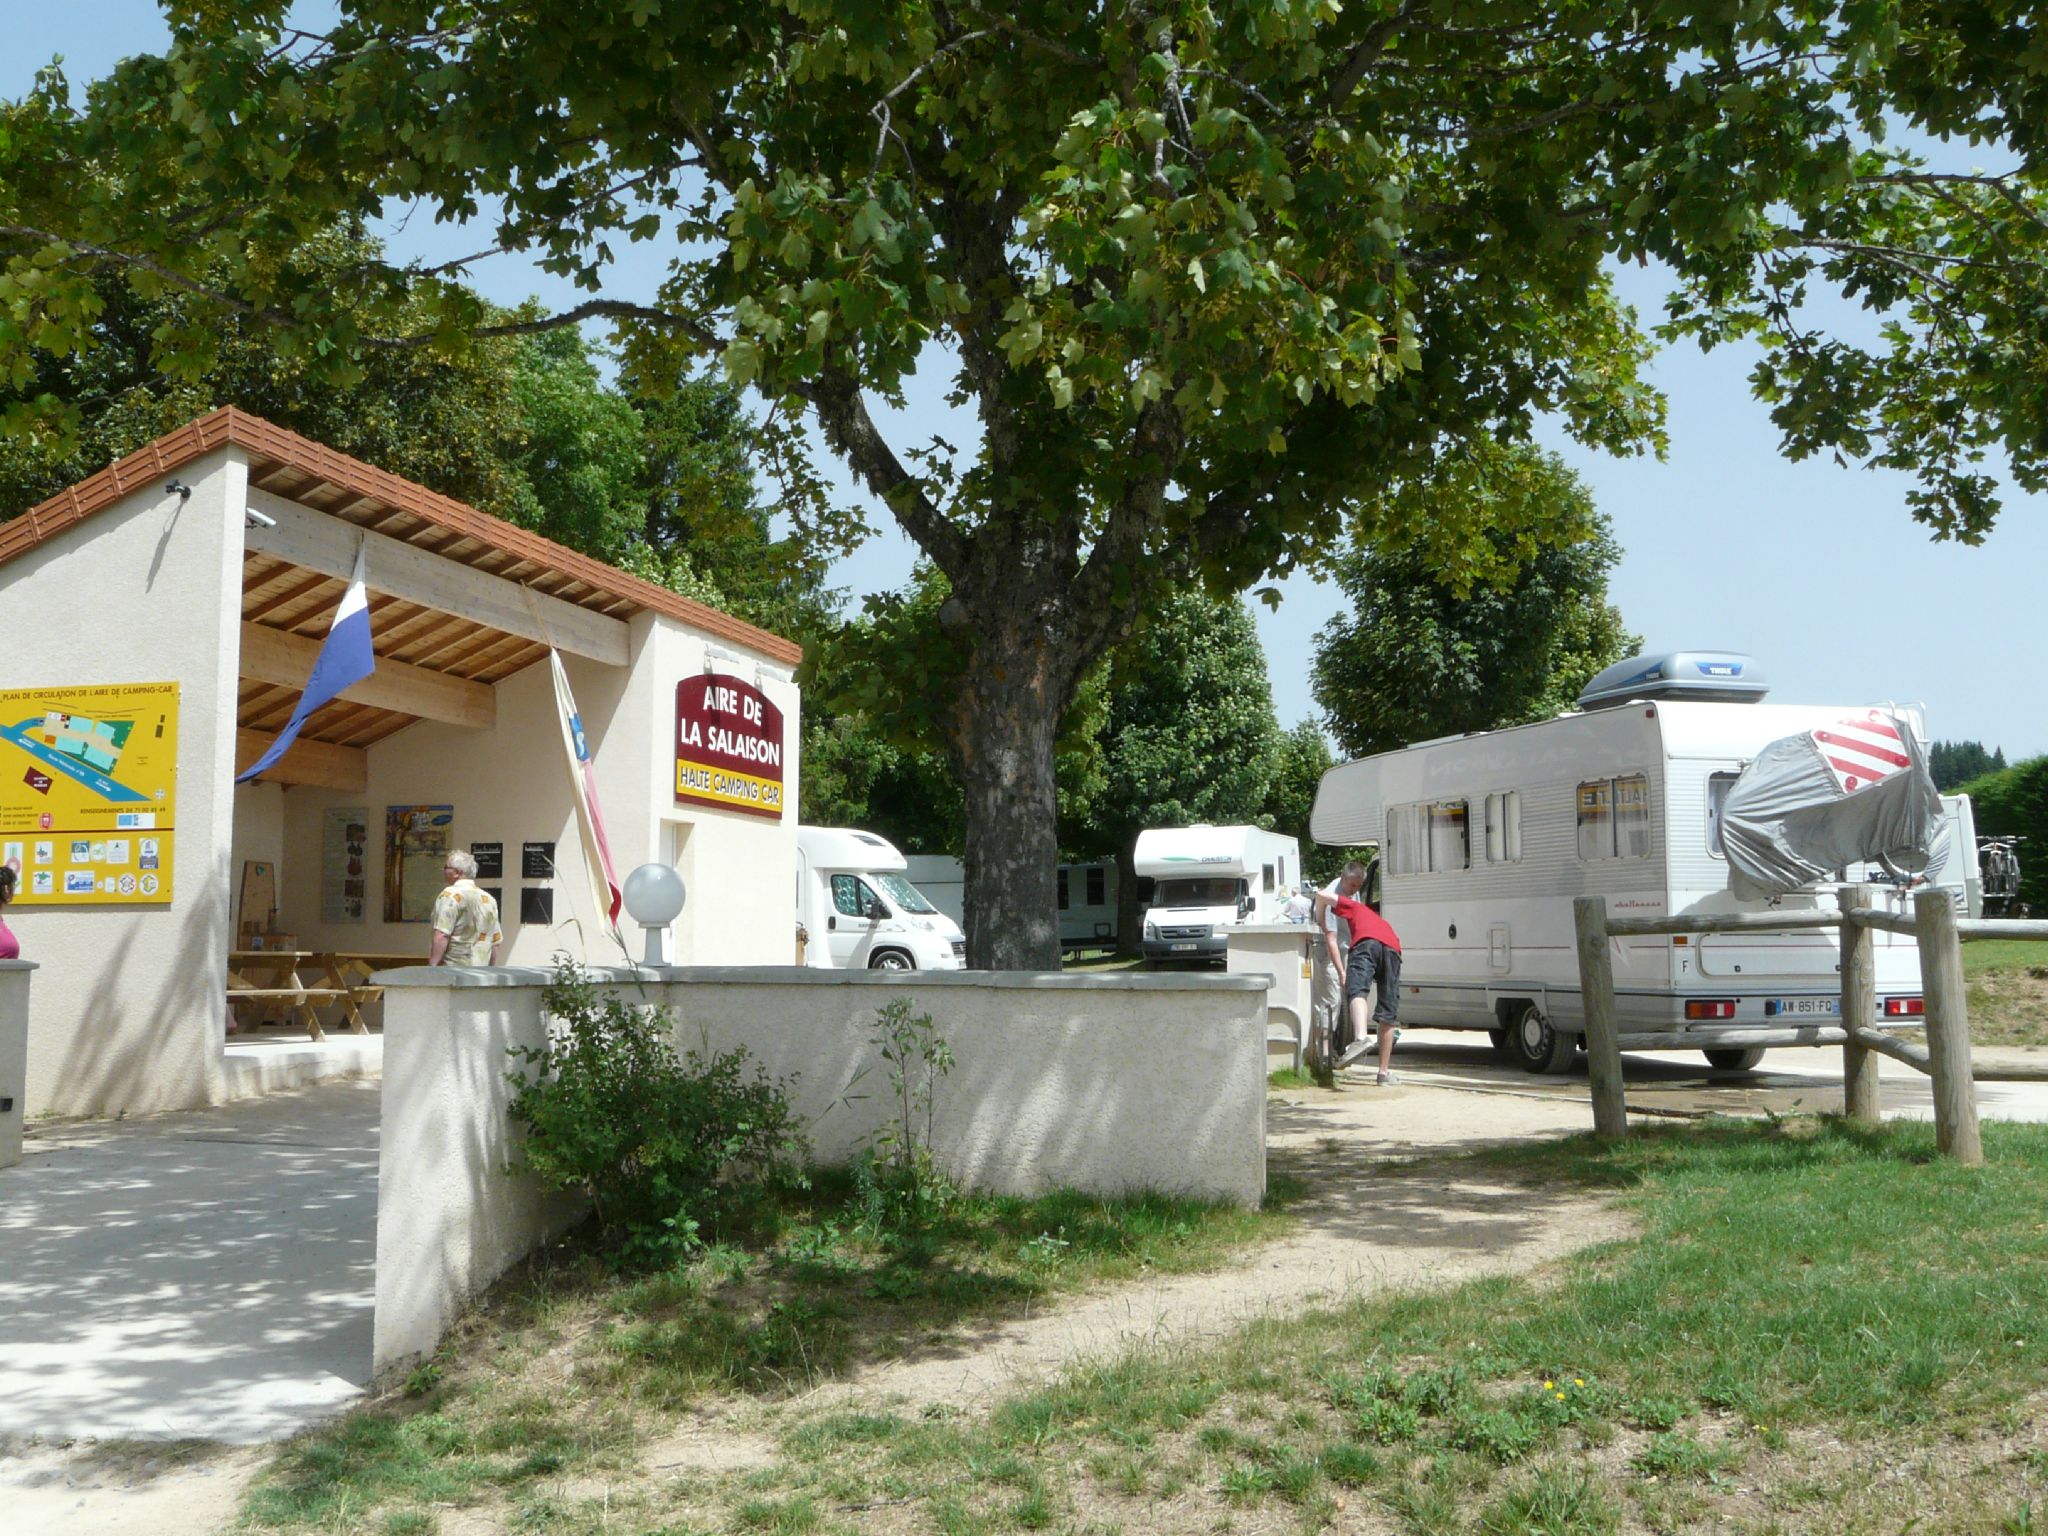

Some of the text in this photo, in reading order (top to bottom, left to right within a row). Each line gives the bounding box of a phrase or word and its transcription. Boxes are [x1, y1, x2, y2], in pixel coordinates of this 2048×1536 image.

[33, 690, 76, 699] CIRCULATION
[703, 686, 763, 726] AIRE DE
[681, 718, 780, 766] LA SALAISON
[680, 766, 780, 805] HALTE CAMPING CAR
[1682, 960, 1688, 973] F
